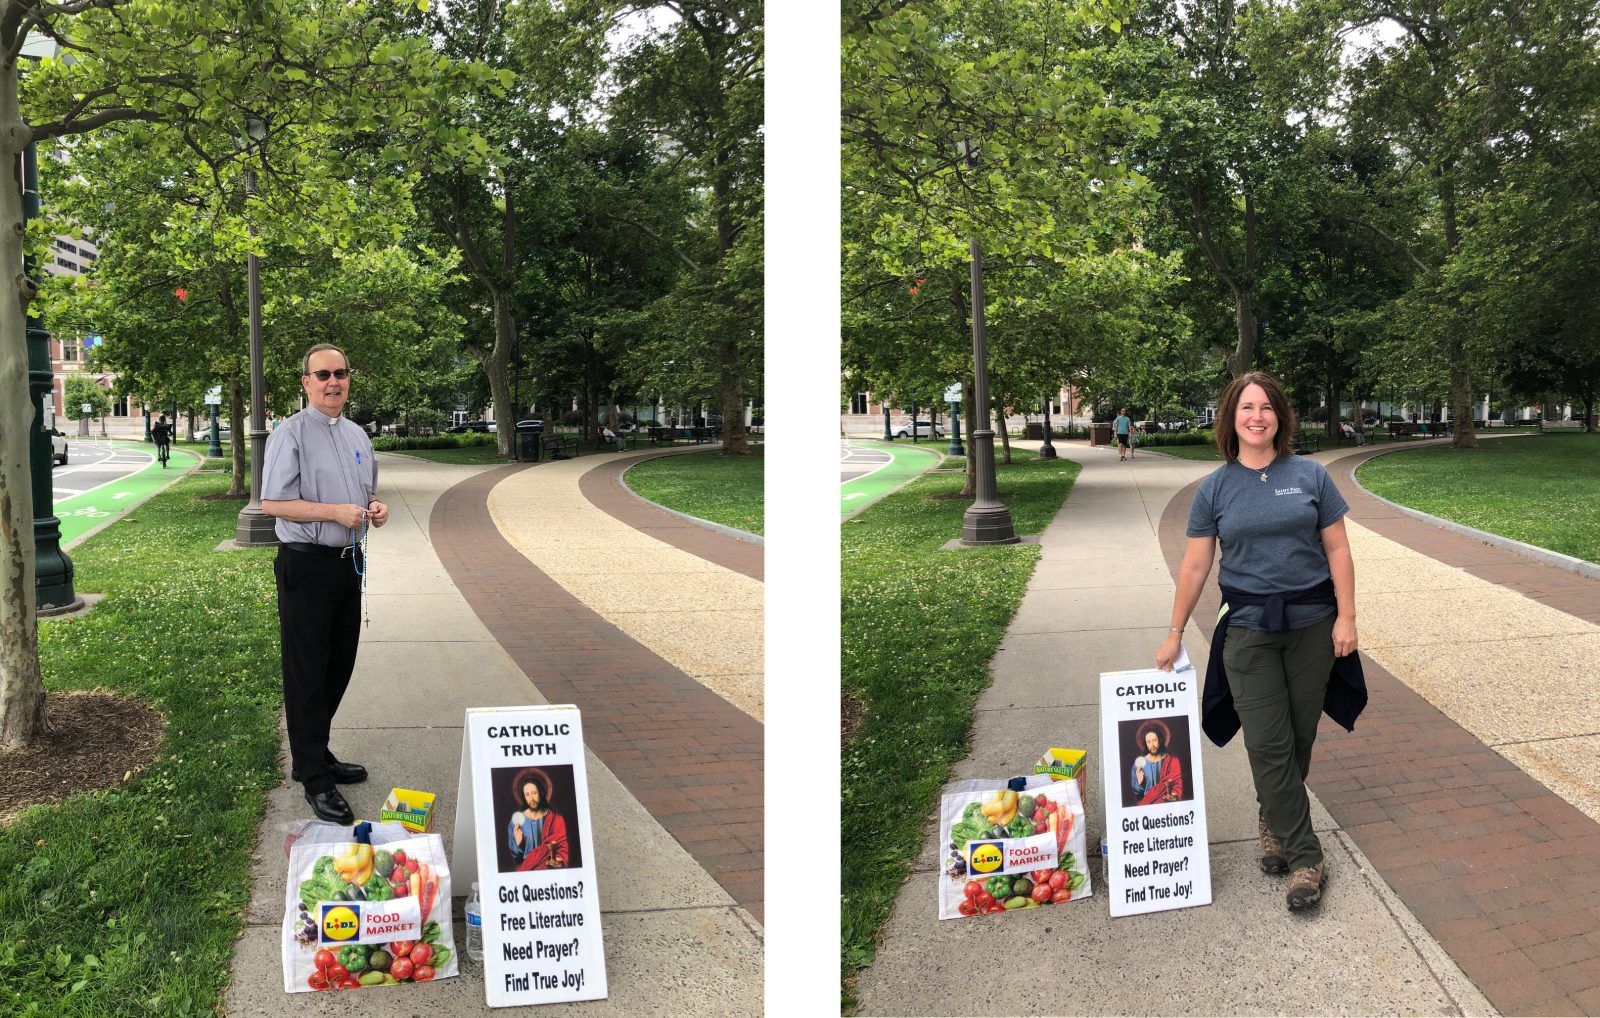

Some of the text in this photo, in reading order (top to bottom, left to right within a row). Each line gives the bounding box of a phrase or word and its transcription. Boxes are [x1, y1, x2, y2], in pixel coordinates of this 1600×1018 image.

[1116, 681, 1187, 697] CATHOLIC
[1127, 698, 1175, 711] TRUTH
[487, 724, 570, 738] CATHOLIC
[501, 743, 557, 757] TRUTH
[403, 814, 423, 825] VALLEY
[1122, 810, 1194, 832] Got Questions?
[1009, 846, 1039, 857] FOOD
[1123, 835, 1193, 855] Free Literature
[1009, 853, 1052, 867] MARKET
[1124, 856, 1189, 878] Need Prayer?
[499, 881, 584, 903] Got Questions?
[1125, 880, 1193, 903] Find True Joy!
[366, 912, 400, 924] FOOD
[501, 910, 584, 931] Free Literature
[366, 922, 415, 935] MARKET
[503, 938, 579, 962] Need Prayer?
[505, 968, 585, 992] Find True Joy!
